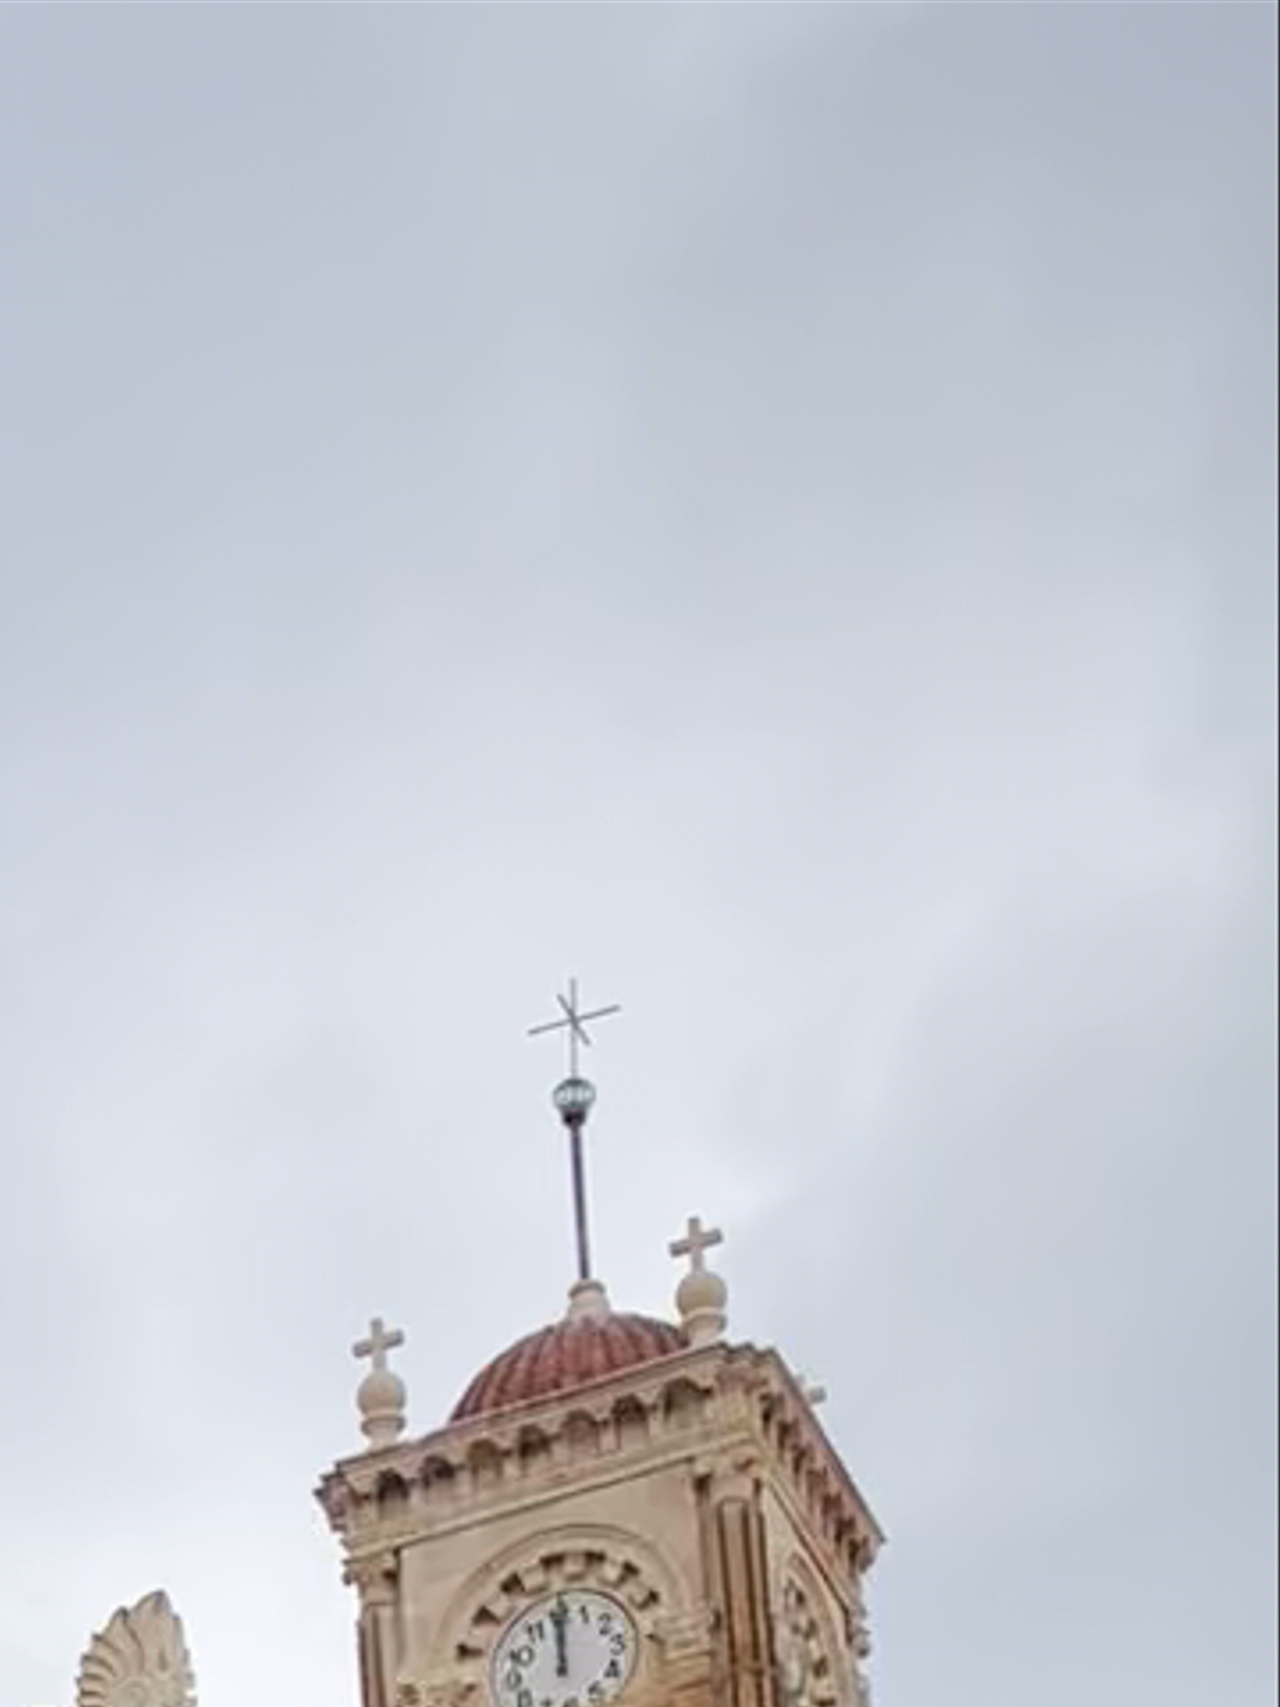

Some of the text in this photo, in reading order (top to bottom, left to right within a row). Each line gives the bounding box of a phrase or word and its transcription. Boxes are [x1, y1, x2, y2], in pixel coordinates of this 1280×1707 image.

[580, 1604, 590, 1623] 1
[599, 1612, 612, 1636] 2
[525, 1620, 544, 1645] 11
[509, 1644, 534, 1667] 10
[609, 1632, 625, 1657] 3
[604, 1658, 620, 1678] 4
